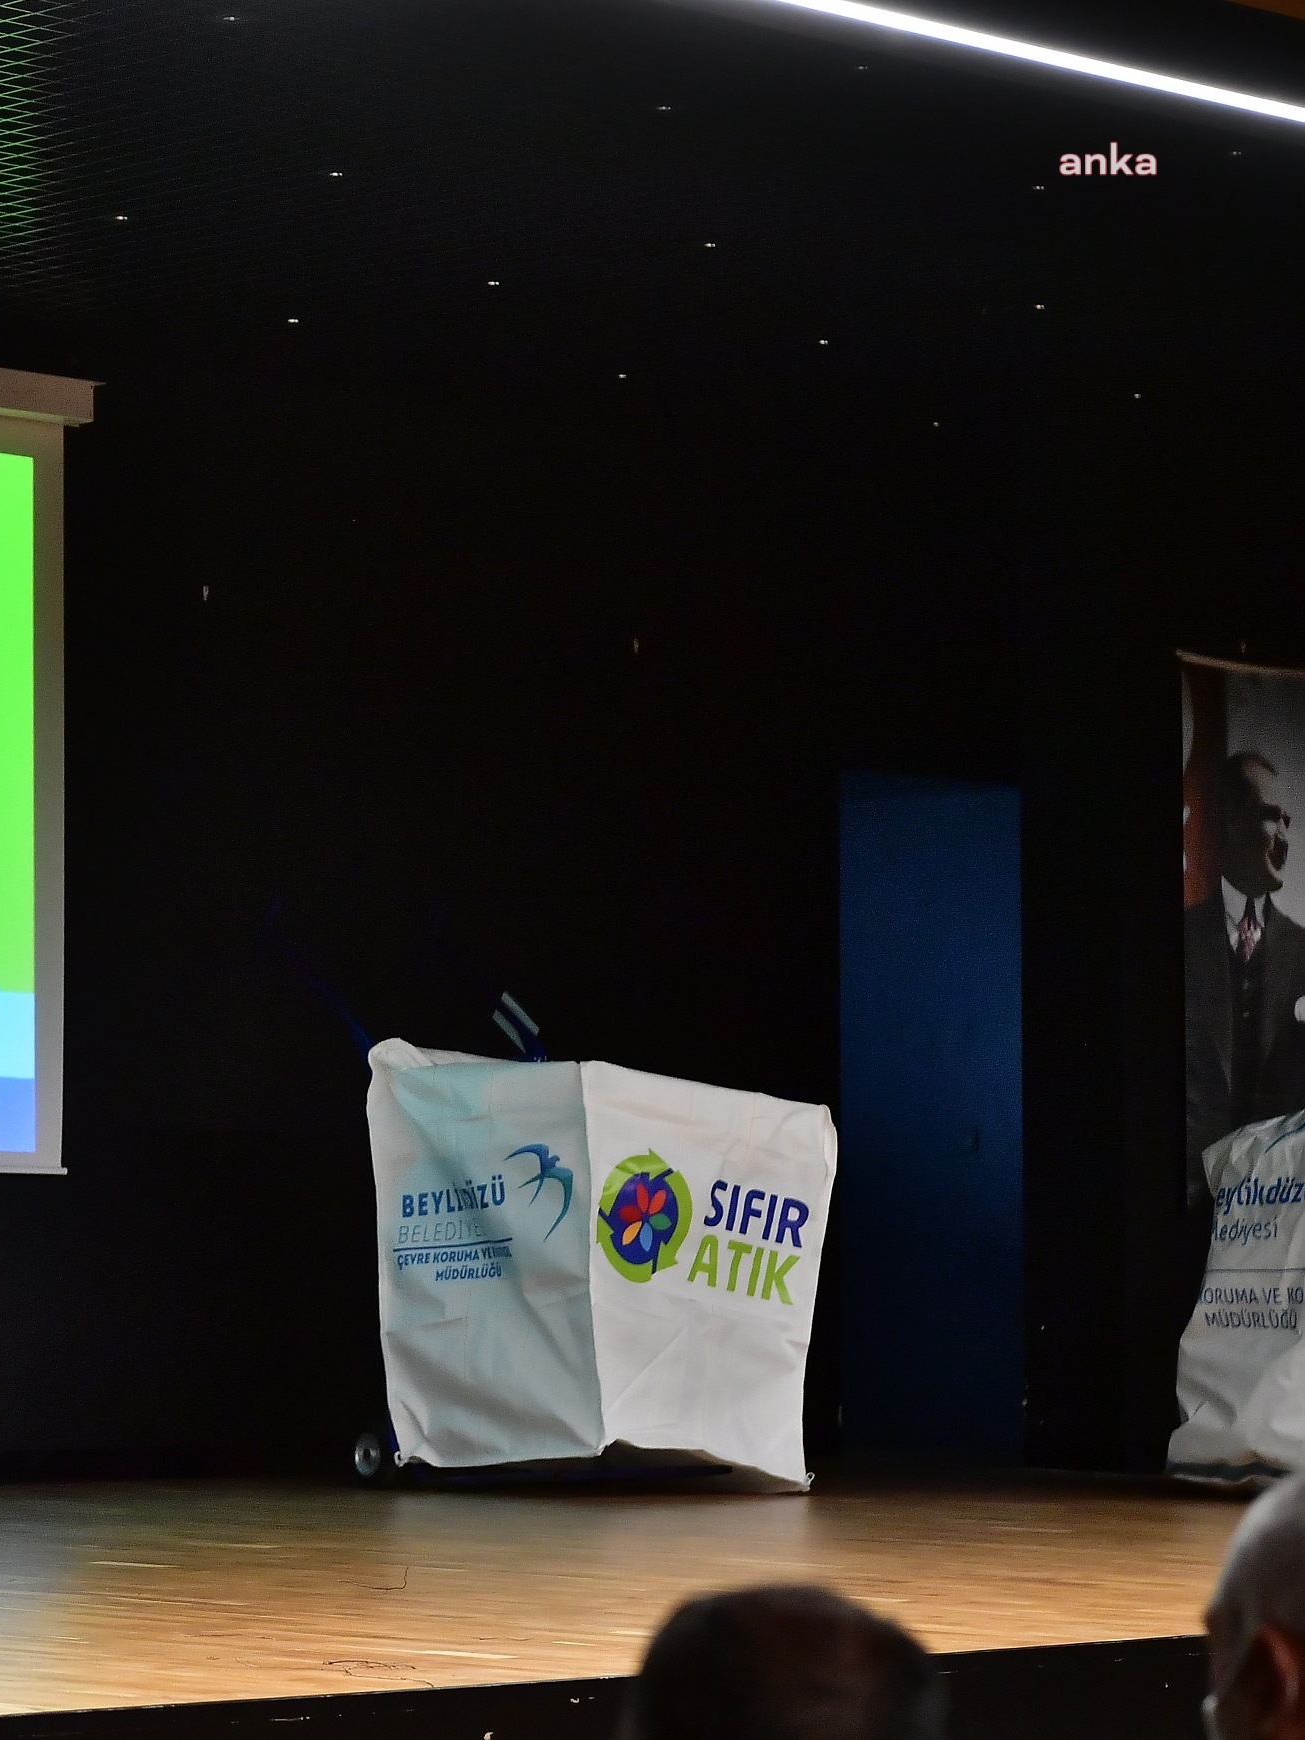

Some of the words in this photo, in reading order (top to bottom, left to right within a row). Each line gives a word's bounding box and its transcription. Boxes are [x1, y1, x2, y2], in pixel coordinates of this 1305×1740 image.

[703, 1178, 810, 1249] SIFIR
[397, 1252, 431, 1271] ÇEVRE
[433, 1250, 480, 1264] KORUMA
[687, 1233, 801, 1305] ATIK
[435, 1262, 502, 1281] MÜDÜRLÜĞÜ
[1201, 1286, 1260, 1305] ORUMA
[1262, 1286, 1282, 1305] VE
[1205, 1307, 1298, 1329] MÜDÜRLÜĞÜ
